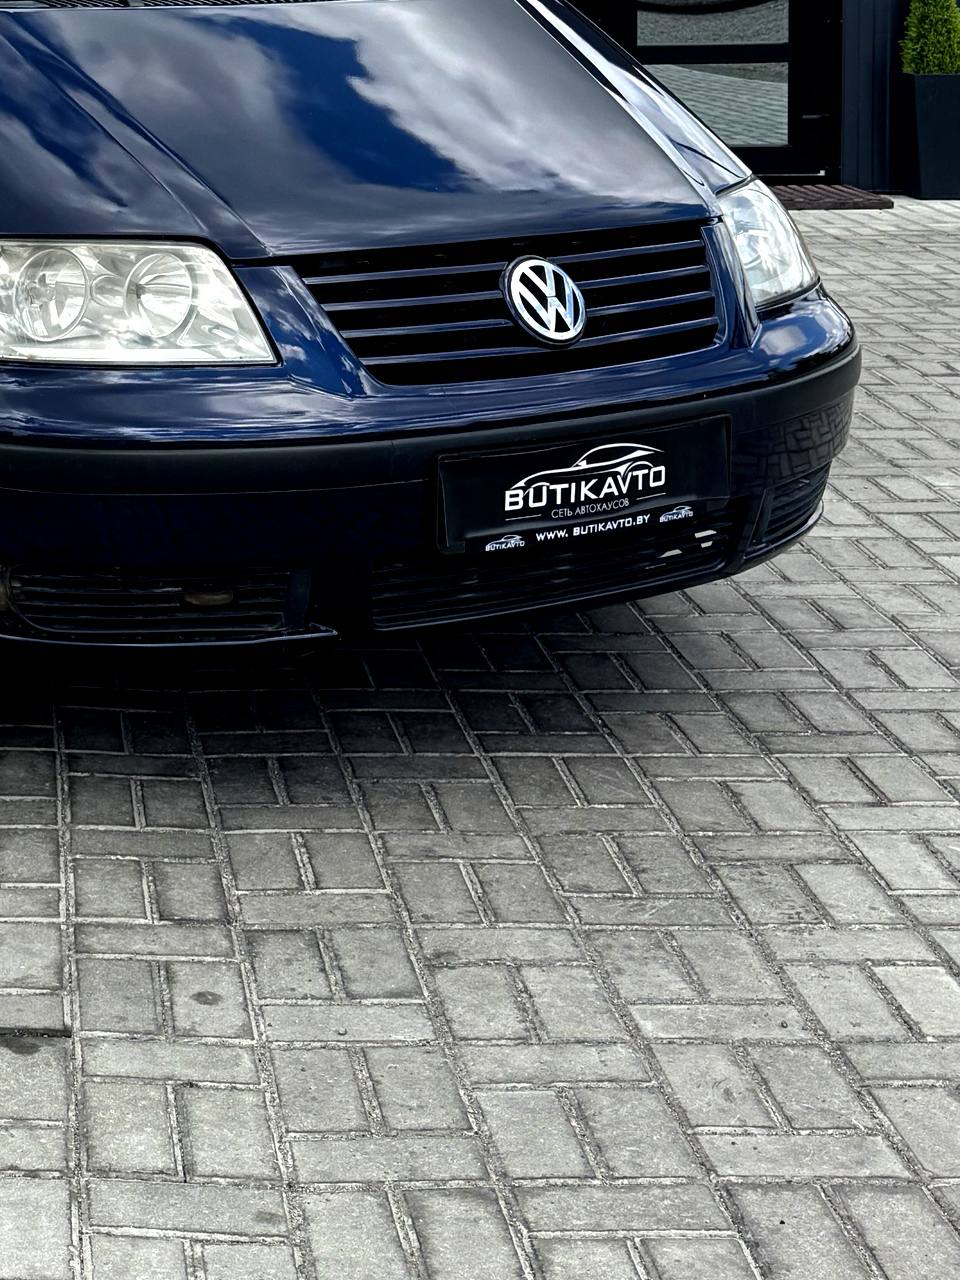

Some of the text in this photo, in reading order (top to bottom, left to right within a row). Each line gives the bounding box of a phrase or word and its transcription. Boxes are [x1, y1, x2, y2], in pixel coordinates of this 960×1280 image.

[504, 466, 666, 511] BUTIKAVTO
[551, 498, 630, 519] СЕТЬ АВТОХАУСОВ
[659, 511, 694, 523] BUTIKAVTO
[573, 514, 651, 536] BUTIKAVTO.BY
[485, 541, 526, 552] BUTIKAVTO
